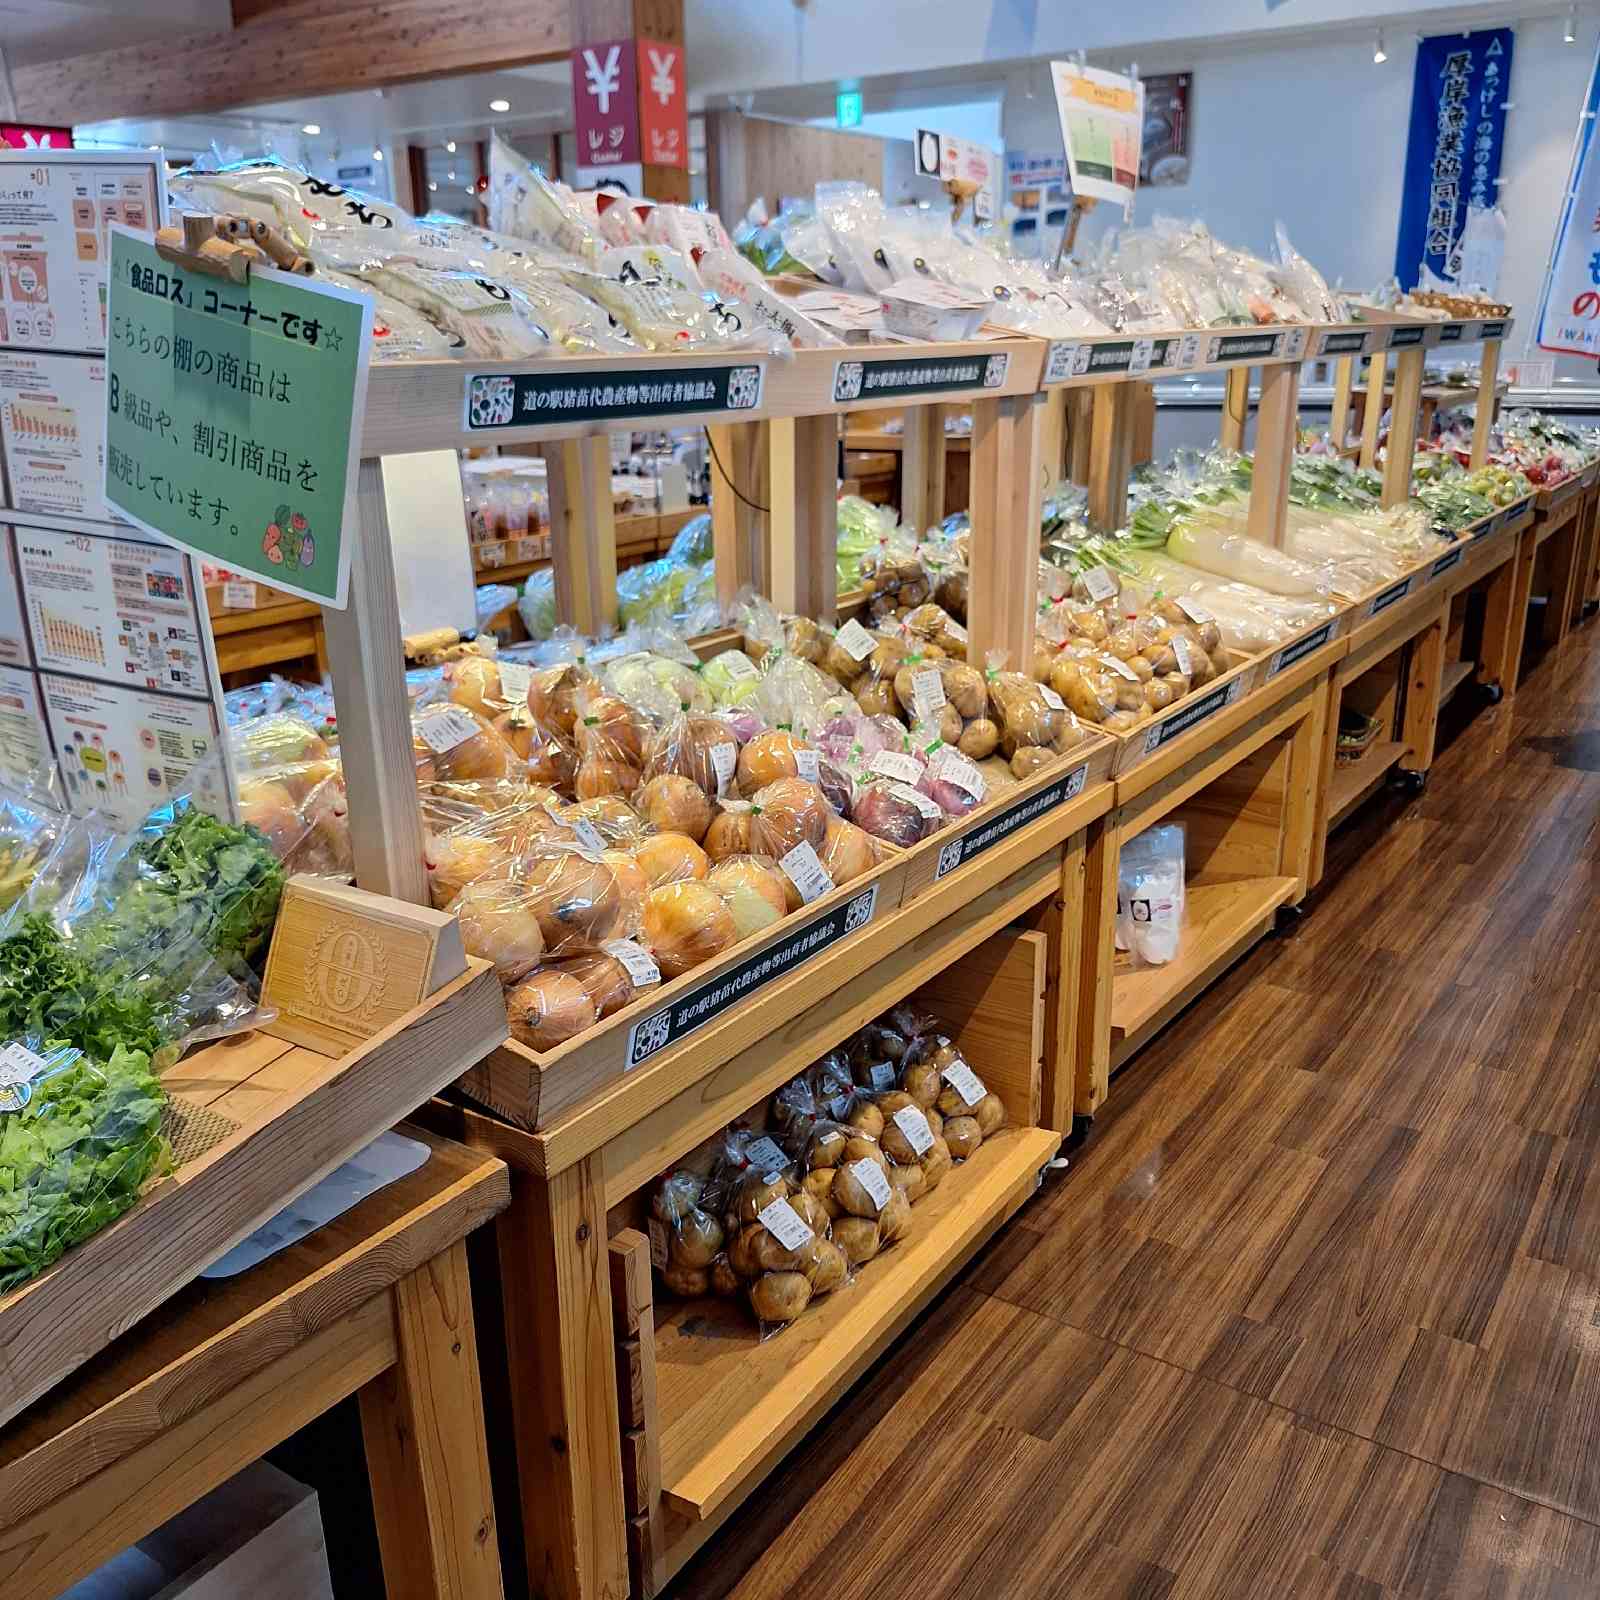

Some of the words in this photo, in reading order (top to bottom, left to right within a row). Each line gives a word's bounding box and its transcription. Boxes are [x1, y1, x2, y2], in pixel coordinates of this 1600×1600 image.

[588, 125, 625, 149] レジ
[113, 315, 292, 404] こちらの棚の商品は
